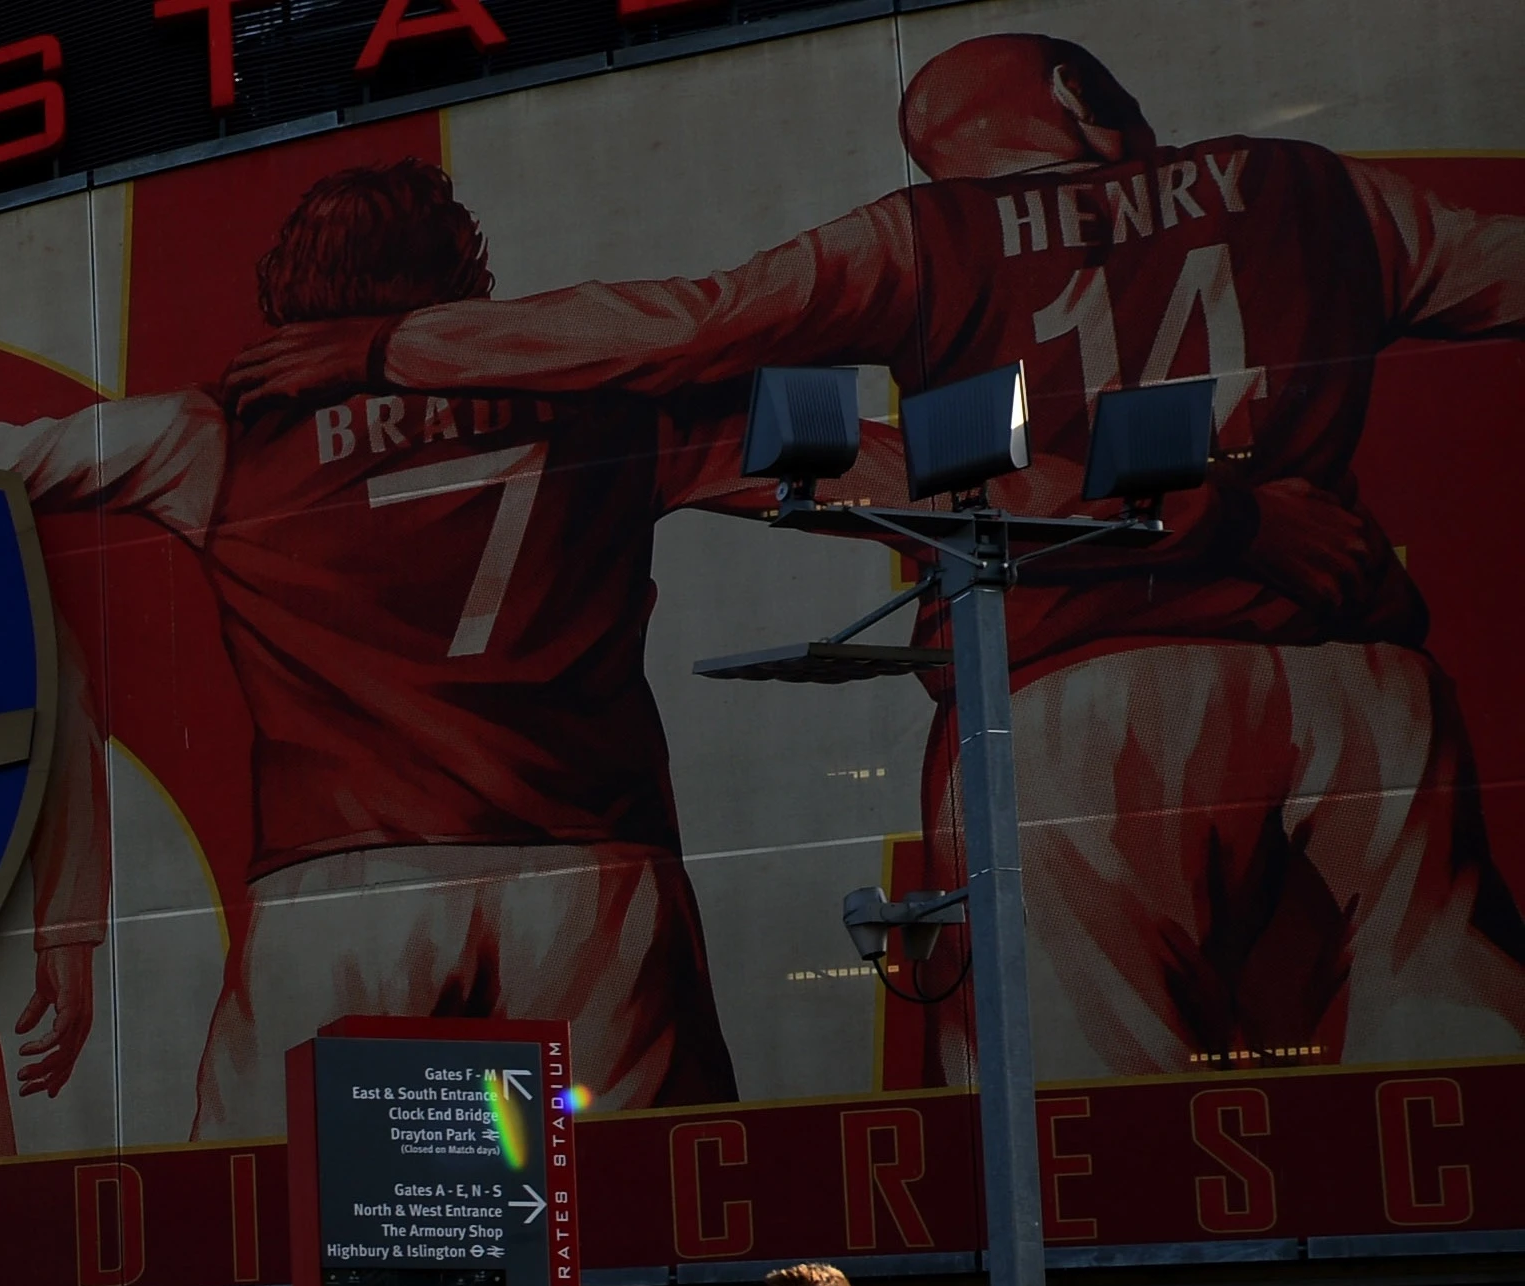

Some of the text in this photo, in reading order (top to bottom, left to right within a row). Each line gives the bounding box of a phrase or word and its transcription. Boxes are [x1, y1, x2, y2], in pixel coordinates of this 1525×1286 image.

[997, 149, 1251, 258] HENRY
[1032, 243, 1268, 437] 14
[366, 441, 548, 657] 7
[424, 1067, 463, 1081] Gates
[466, 1068, 473, 1081] F
[484, 1068, 497, 1081] M
[352, 1086, 498, 1101] East & South Entrance
[549, 1042, 568, 1167] STADIUM
[389, 1107, 499, 1124] Clock End Bridge
[391, 1127, 476, 1143] Drayton Park
[401, 1145, 433, 1155] (Closed
[448, 1145, 475, 1154] Match
[477, 1145, 500, 1156] days)
[669, 1078, 1475, 1260] CRESC
[394, 1183, 432, 1197] Gates
[435, 1184, 445, 1197] A
[456, 1184, 468, 1199] E,
[472, 1184, 481, 1197] N
[493, 1184, 502, 1197] S
[354, 1203, 503, 1217] North & West Entrance
[381, 1223, 503, 1241] The Armoury Shop
[327, 1243, 466, 1261] Highbury & Islington
